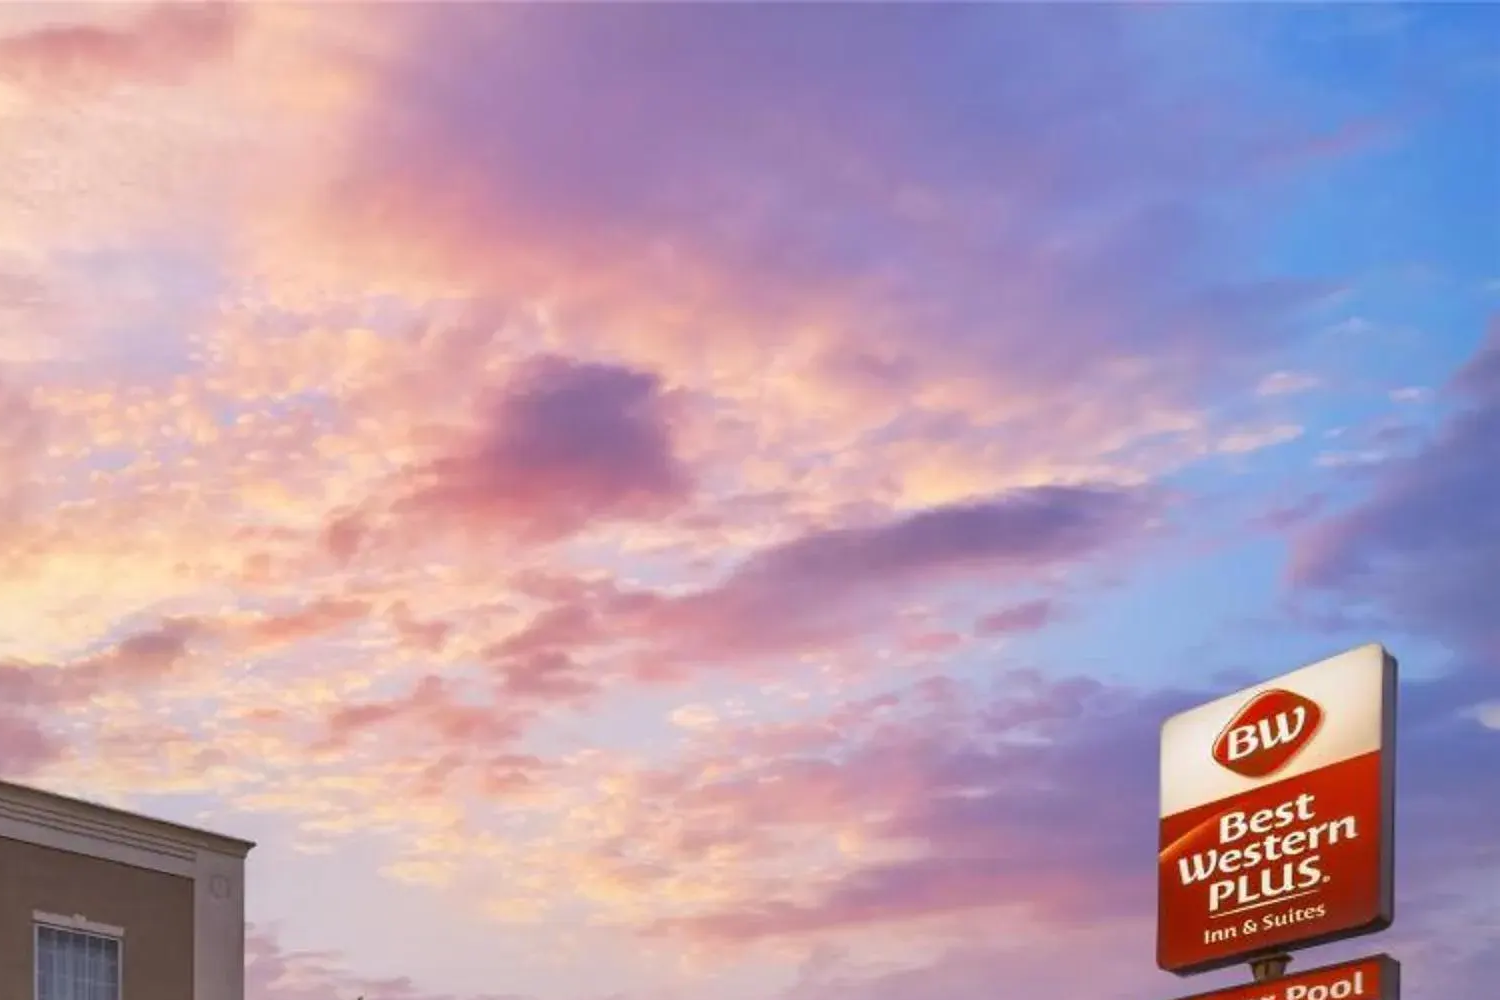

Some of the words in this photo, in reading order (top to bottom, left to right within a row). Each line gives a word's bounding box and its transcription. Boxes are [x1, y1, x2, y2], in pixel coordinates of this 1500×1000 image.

[1227, 706, 1305, 761] BW
[1219, 793, 1316, 844] Best
[1178, 815, 1359, 886] Western
[1209, 855, 1322, 912] PLUS
[1204, 926, 1237, 944] Inn
[1243, 920, 1257, 935] &
[1262, 903, 1326, 931] Suites
